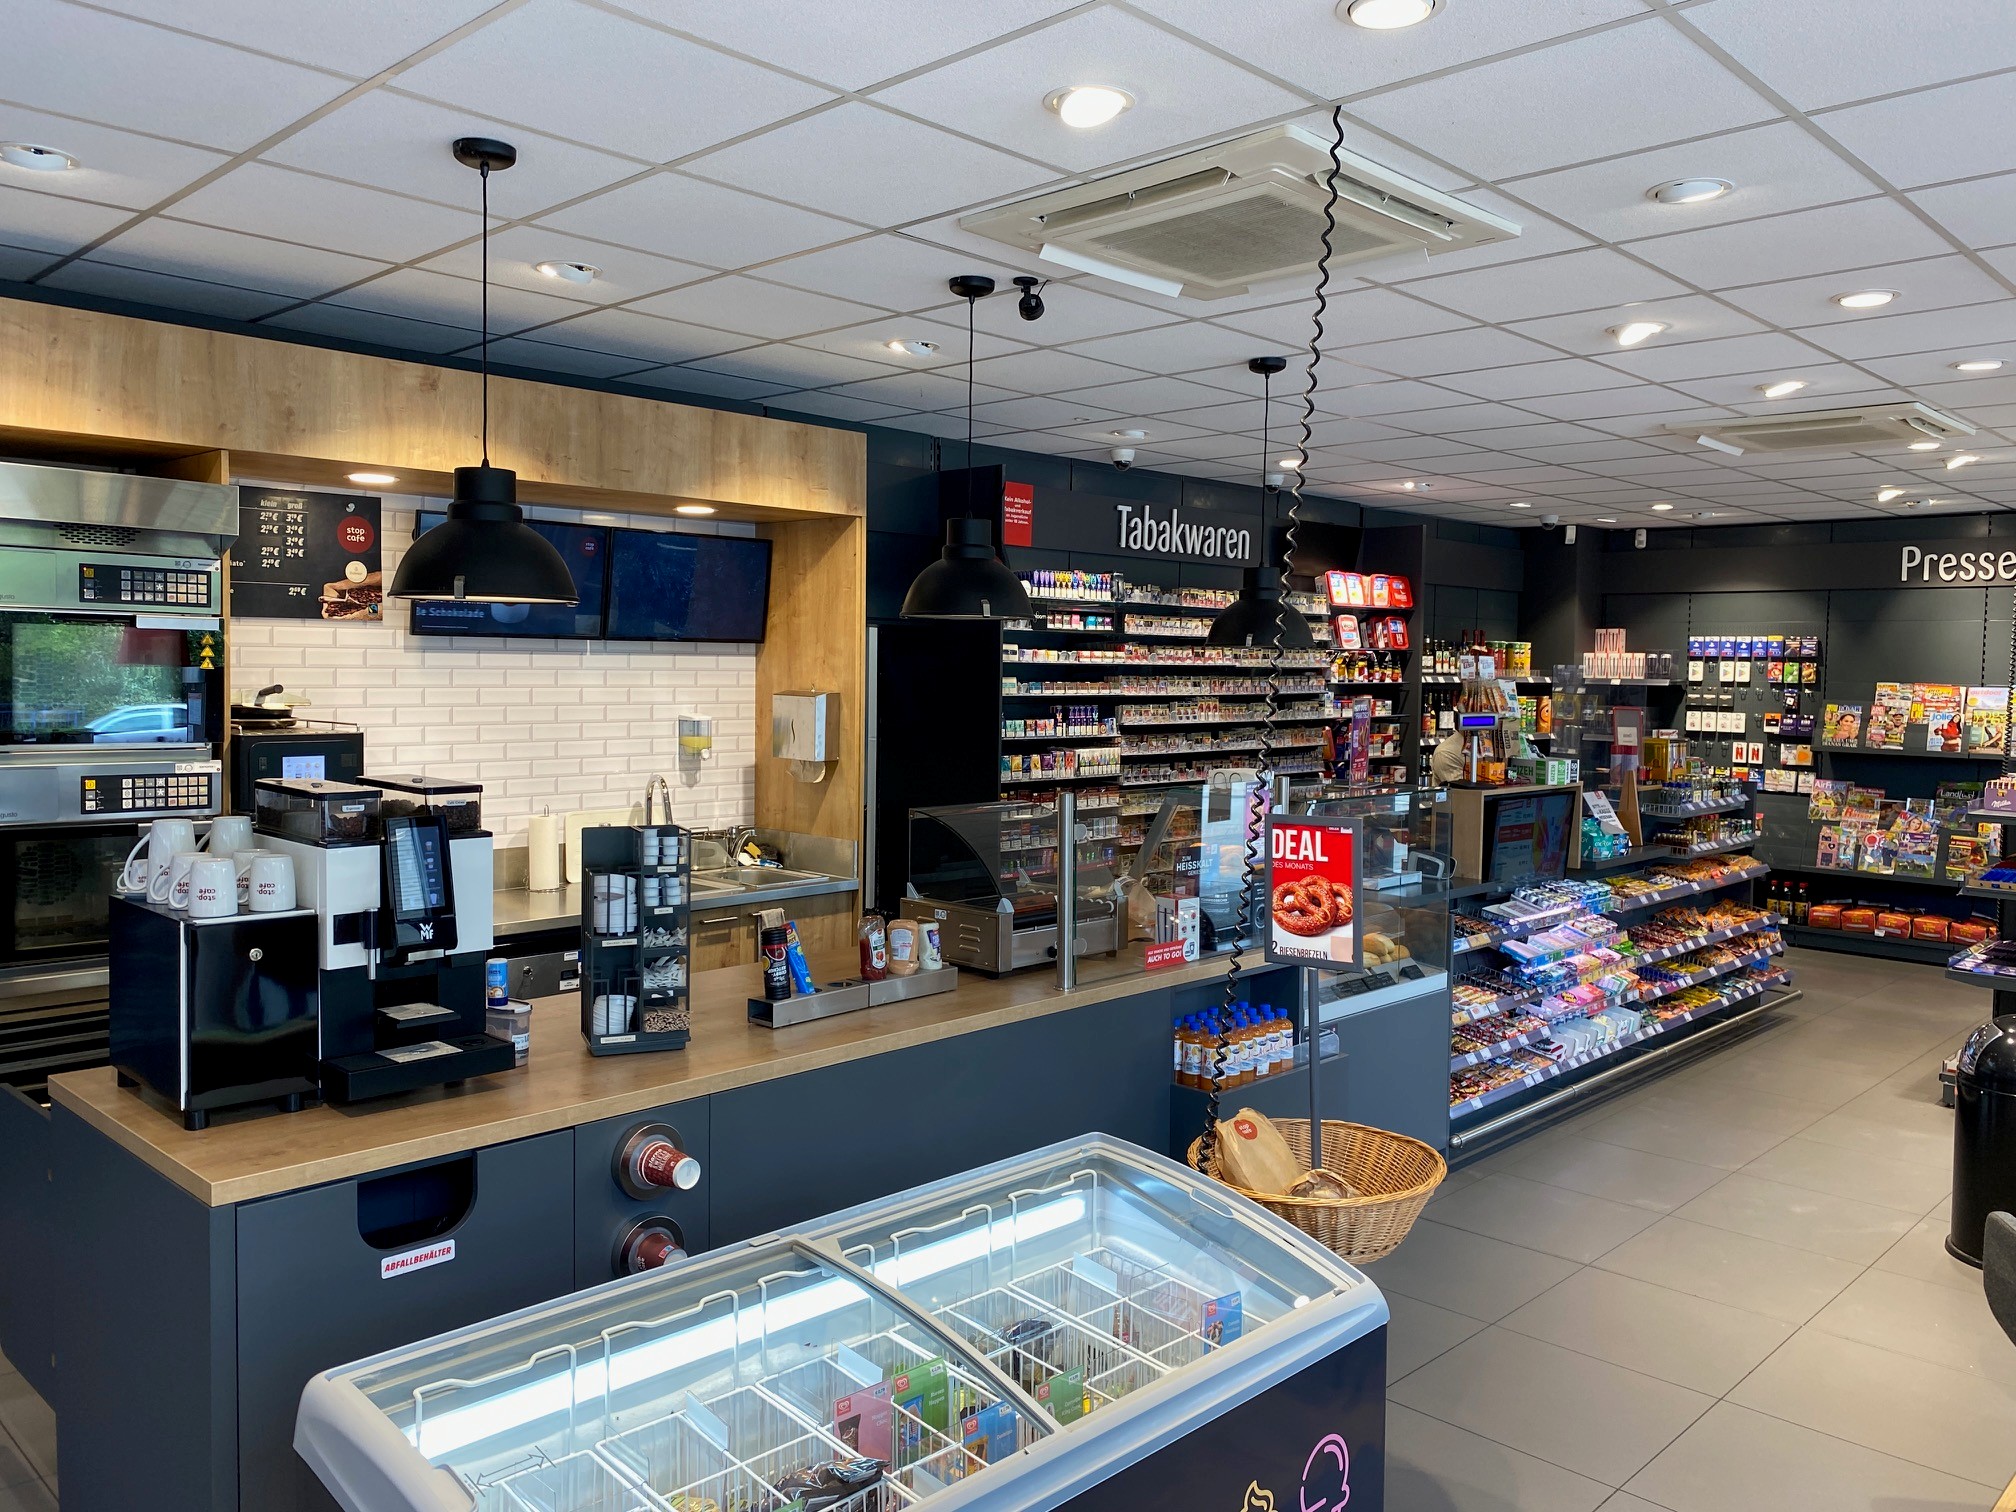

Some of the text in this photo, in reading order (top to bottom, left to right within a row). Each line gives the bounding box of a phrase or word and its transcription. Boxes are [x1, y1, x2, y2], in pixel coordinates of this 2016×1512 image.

[1116, 504, 1250, 560] Tabakwaren
[1901, 546, 2016, 582] Presse
[429, 608, 484, 618] Schokolade
[1931, 712, 1953, 721] Jolie
[1815, 780, 1846, 790] AirFryer
[1272, 829, 1328, 862] DEAL
[1176, 859, 1213, 871] HEISSKALT
[1285, 862, 1313, 870] MONATS
[1147, 954, 1162, 963] AUCH
[1172, 950, 1182, 959] GO!
[1272, 941, 1328, 960] 2 RIESENBREZELN
[385, 1246, 452, 1272] ABFALLBEHÄLTER
